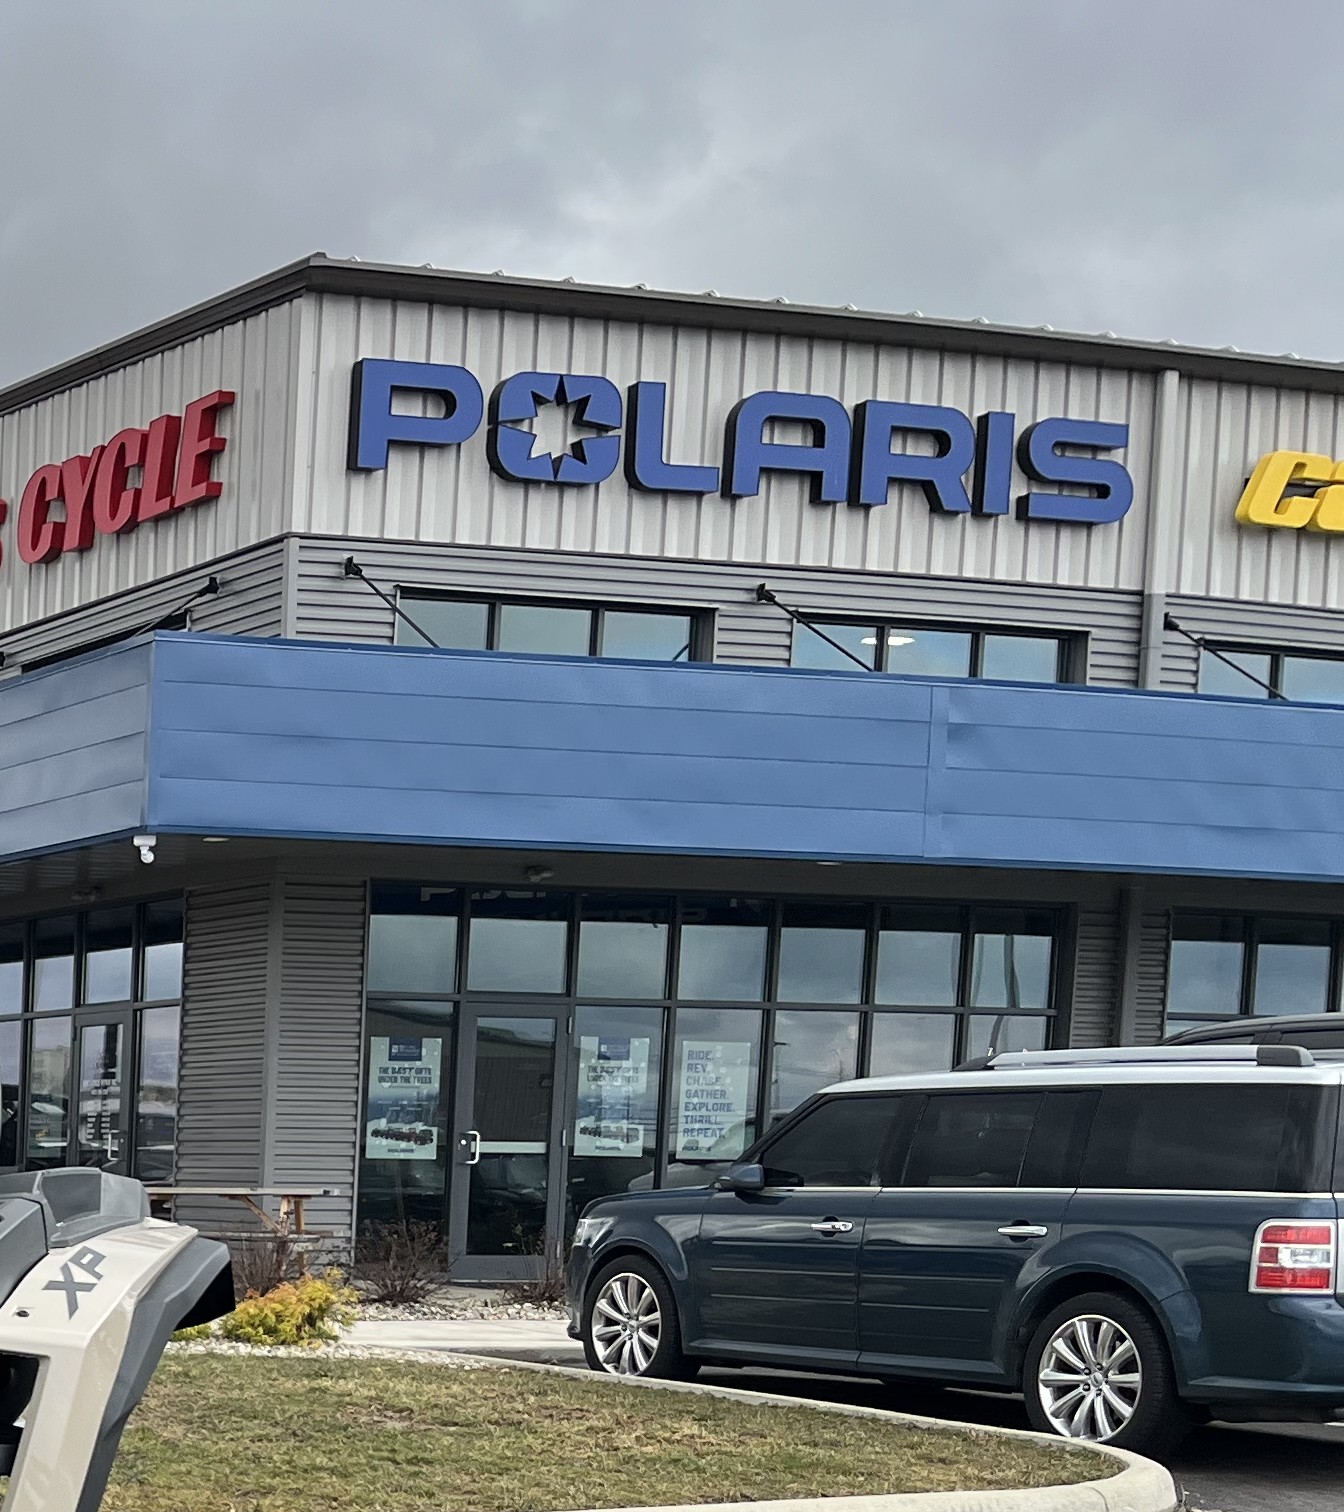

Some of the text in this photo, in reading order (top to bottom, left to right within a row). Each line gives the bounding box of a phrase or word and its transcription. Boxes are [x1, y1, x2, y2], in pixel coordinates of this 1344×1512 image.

[17, 389, 235, 565] CYCLE
[347, 357, 1135, 525] POLARIS
[42, 1246, 107, 1319] XP
